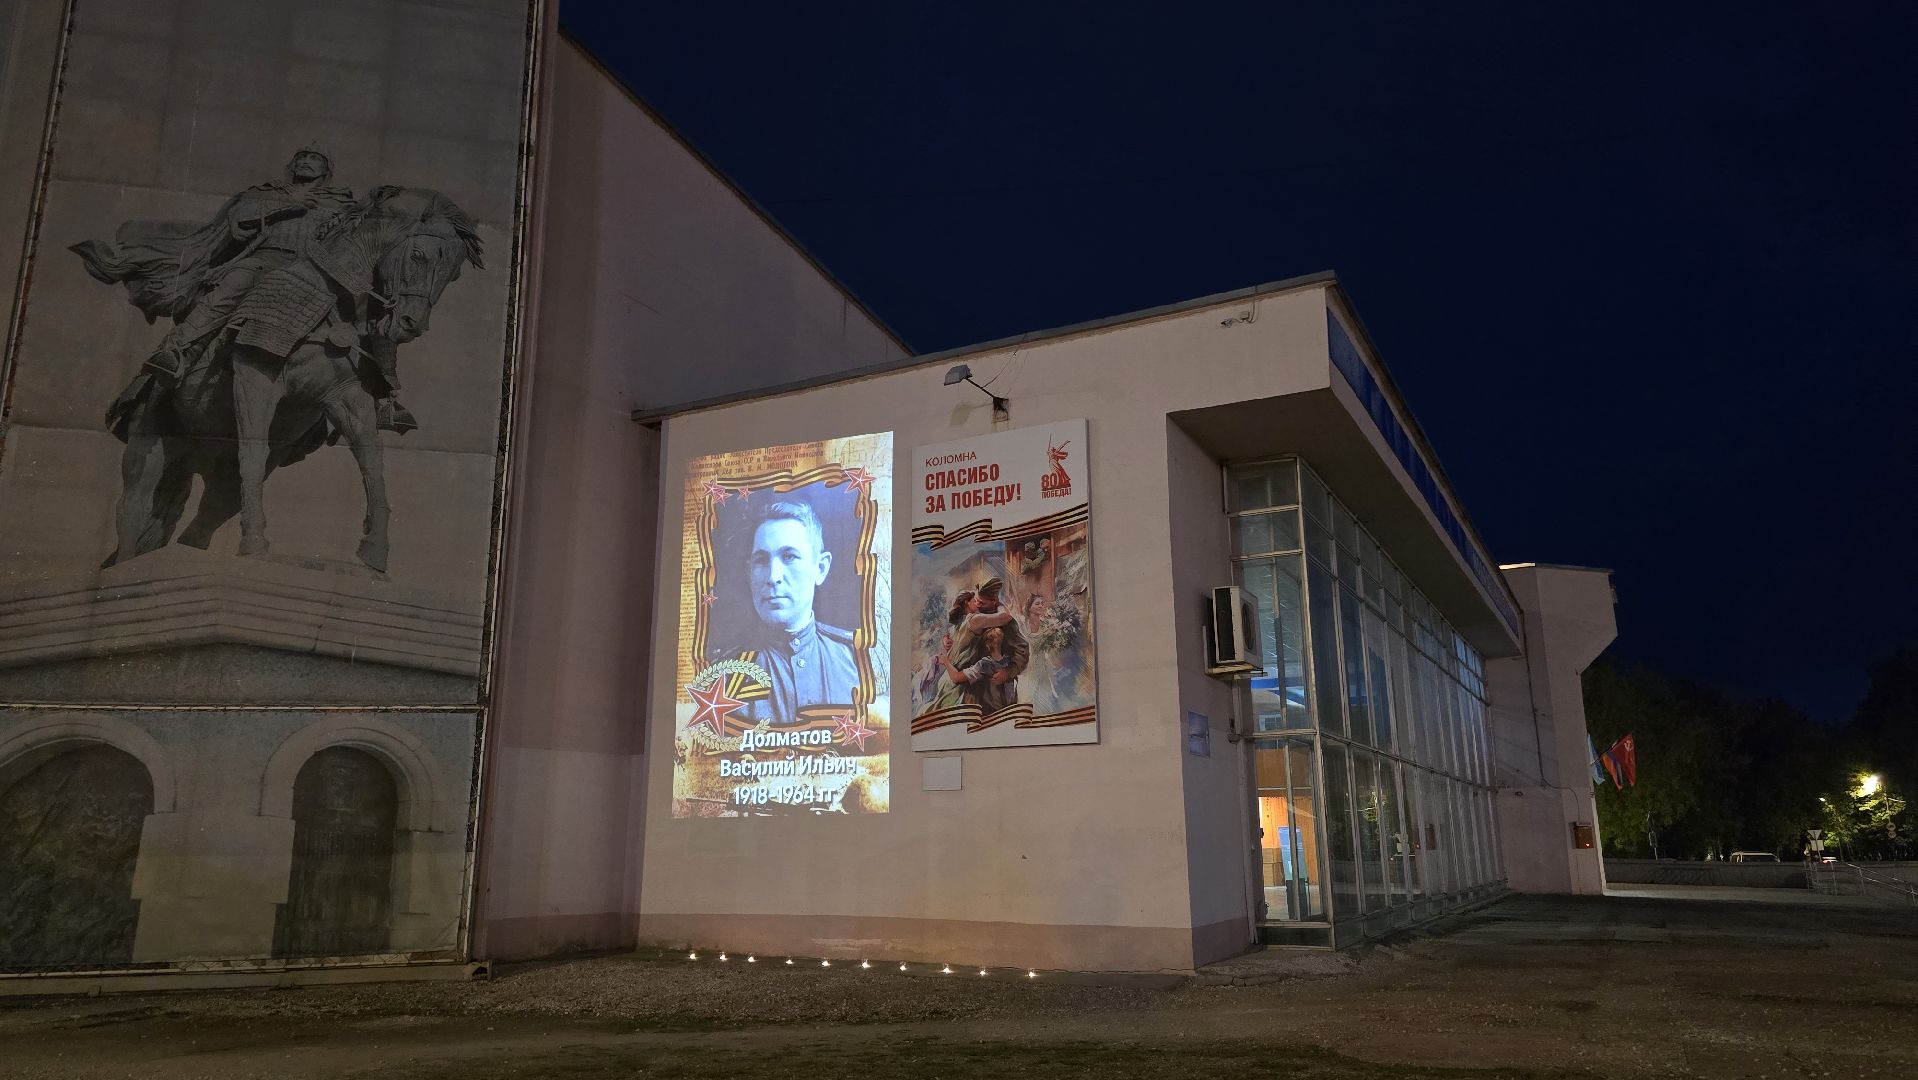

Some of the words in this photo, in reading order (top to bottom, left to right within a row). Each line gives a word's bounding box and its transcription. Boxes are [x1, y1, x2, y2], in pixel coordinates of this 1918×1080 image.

[925, 450, 977, 468] КОЛОМНА
[925, 463, 1000, 491] СПАСИБО
[925, 495, 946, 514] ЗА
[951, 483, 1021, 510] ПОБЕДУ!
[1041, 487, 1072, 499] ПОБЕДА!
[739, 729, 832, 752] Долматов
[720, 755, 795, 777] Василий
[799, 755, 857, 775] Ильич
[734, 785, 815, 805] 1918-1964
